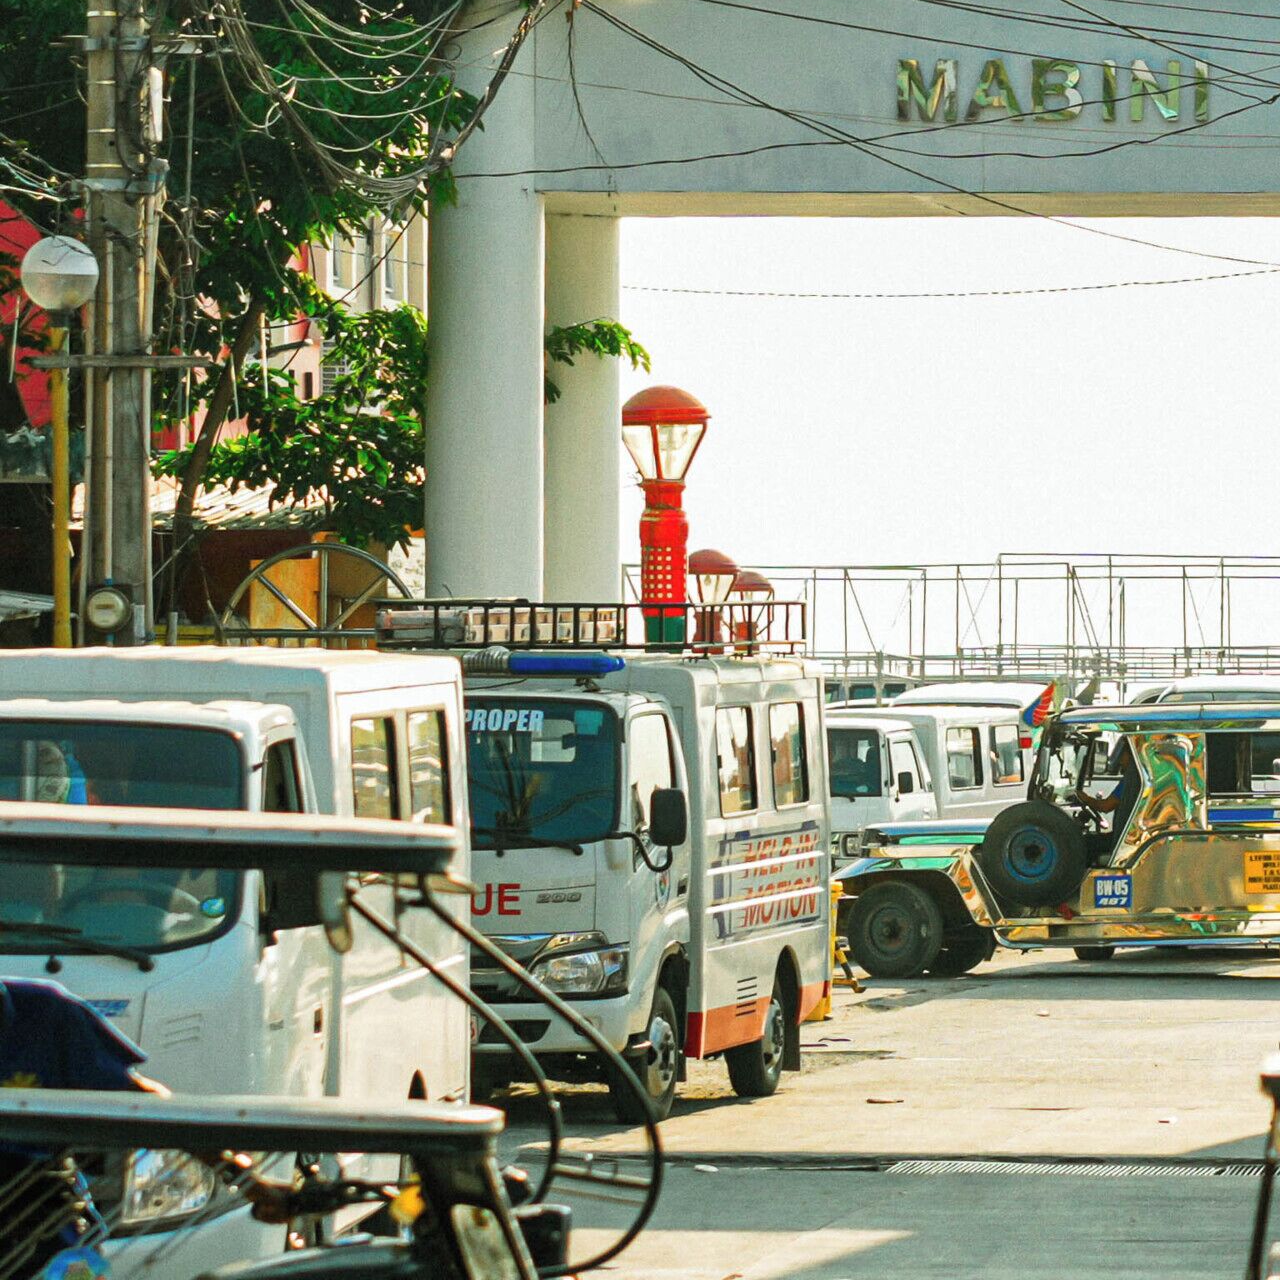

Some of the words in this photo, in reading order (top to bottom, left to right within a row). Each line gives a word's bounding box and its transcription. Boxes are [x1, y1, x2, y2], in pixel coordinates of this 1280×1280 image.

[897, 58, 1210, 122] MABINI
[464, 708, 545, 732] PROPER
[536, 891, 582, 904] 200
